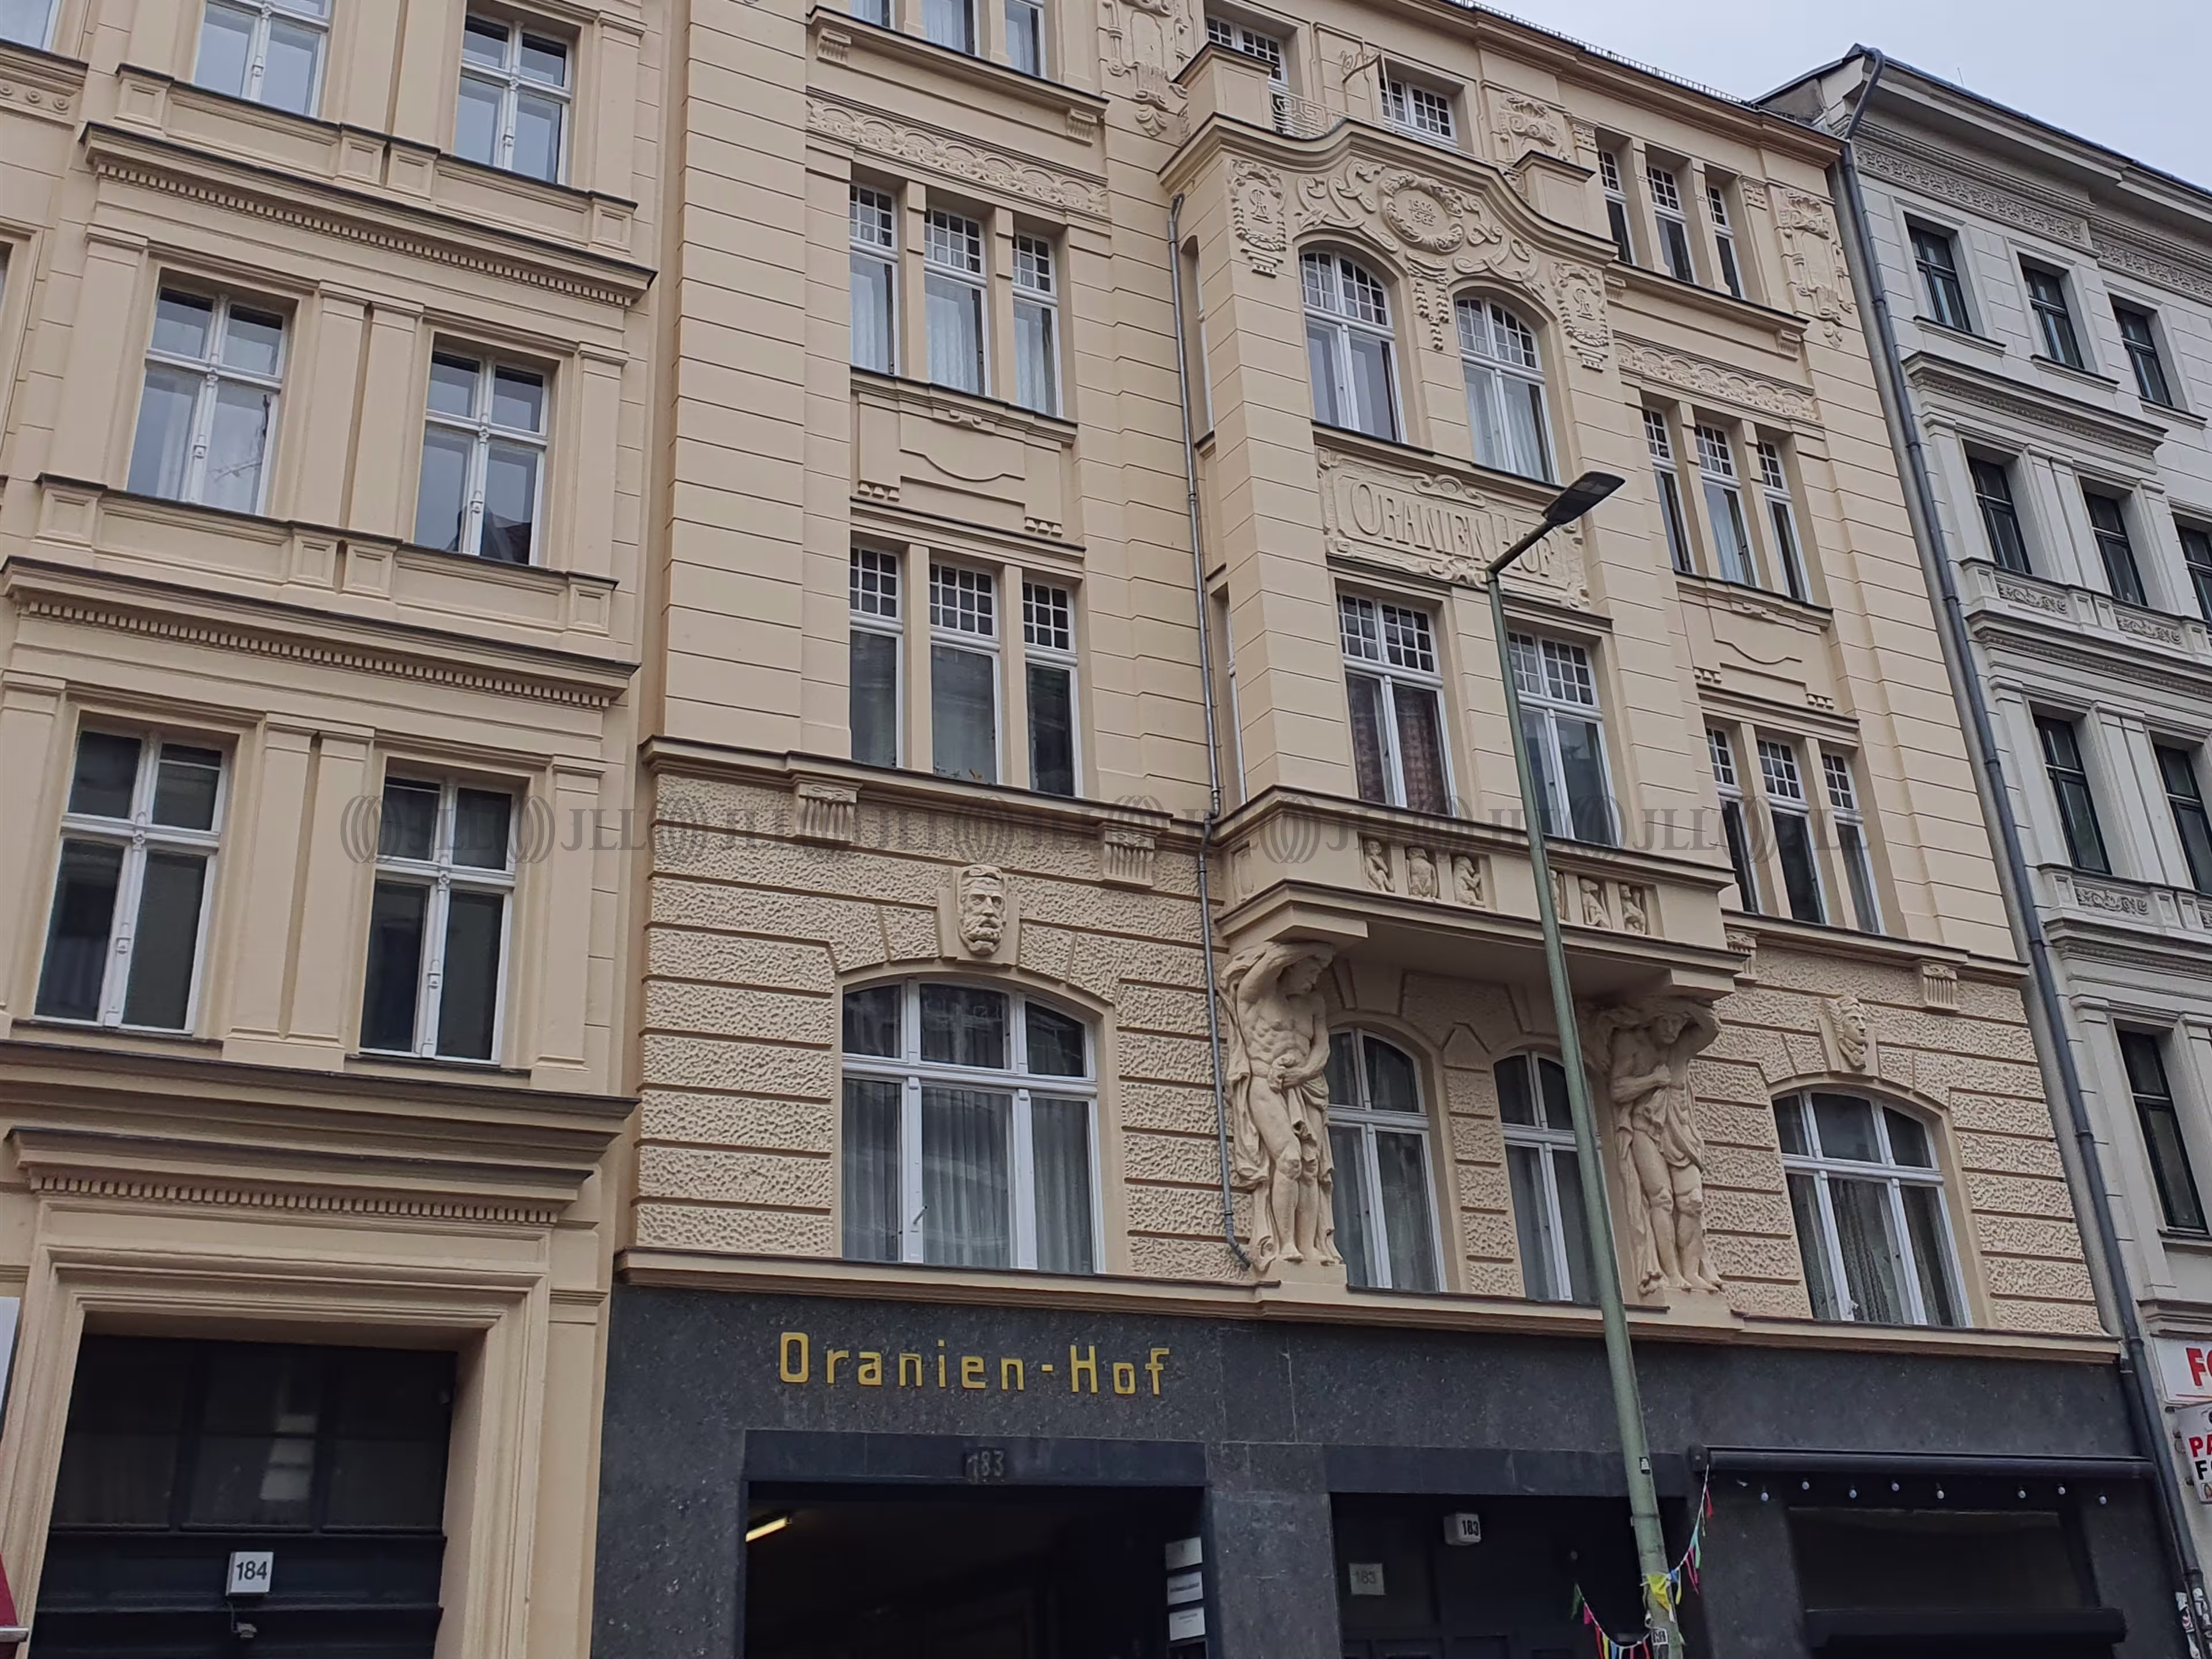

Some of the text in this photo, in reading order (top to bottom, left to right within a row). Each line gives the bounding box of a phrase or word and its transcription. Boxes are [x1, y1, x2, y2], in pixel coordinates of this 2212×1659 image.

[1350, 480, 1494, 564] ORANIEN
[779, 1332, 1171, 1395] Oranien-Hof
[967, 1450, 1004, 1480] 183
[1462, 1520, 1479, 1536] 183
[236, 1560, 267, 1581] 184
